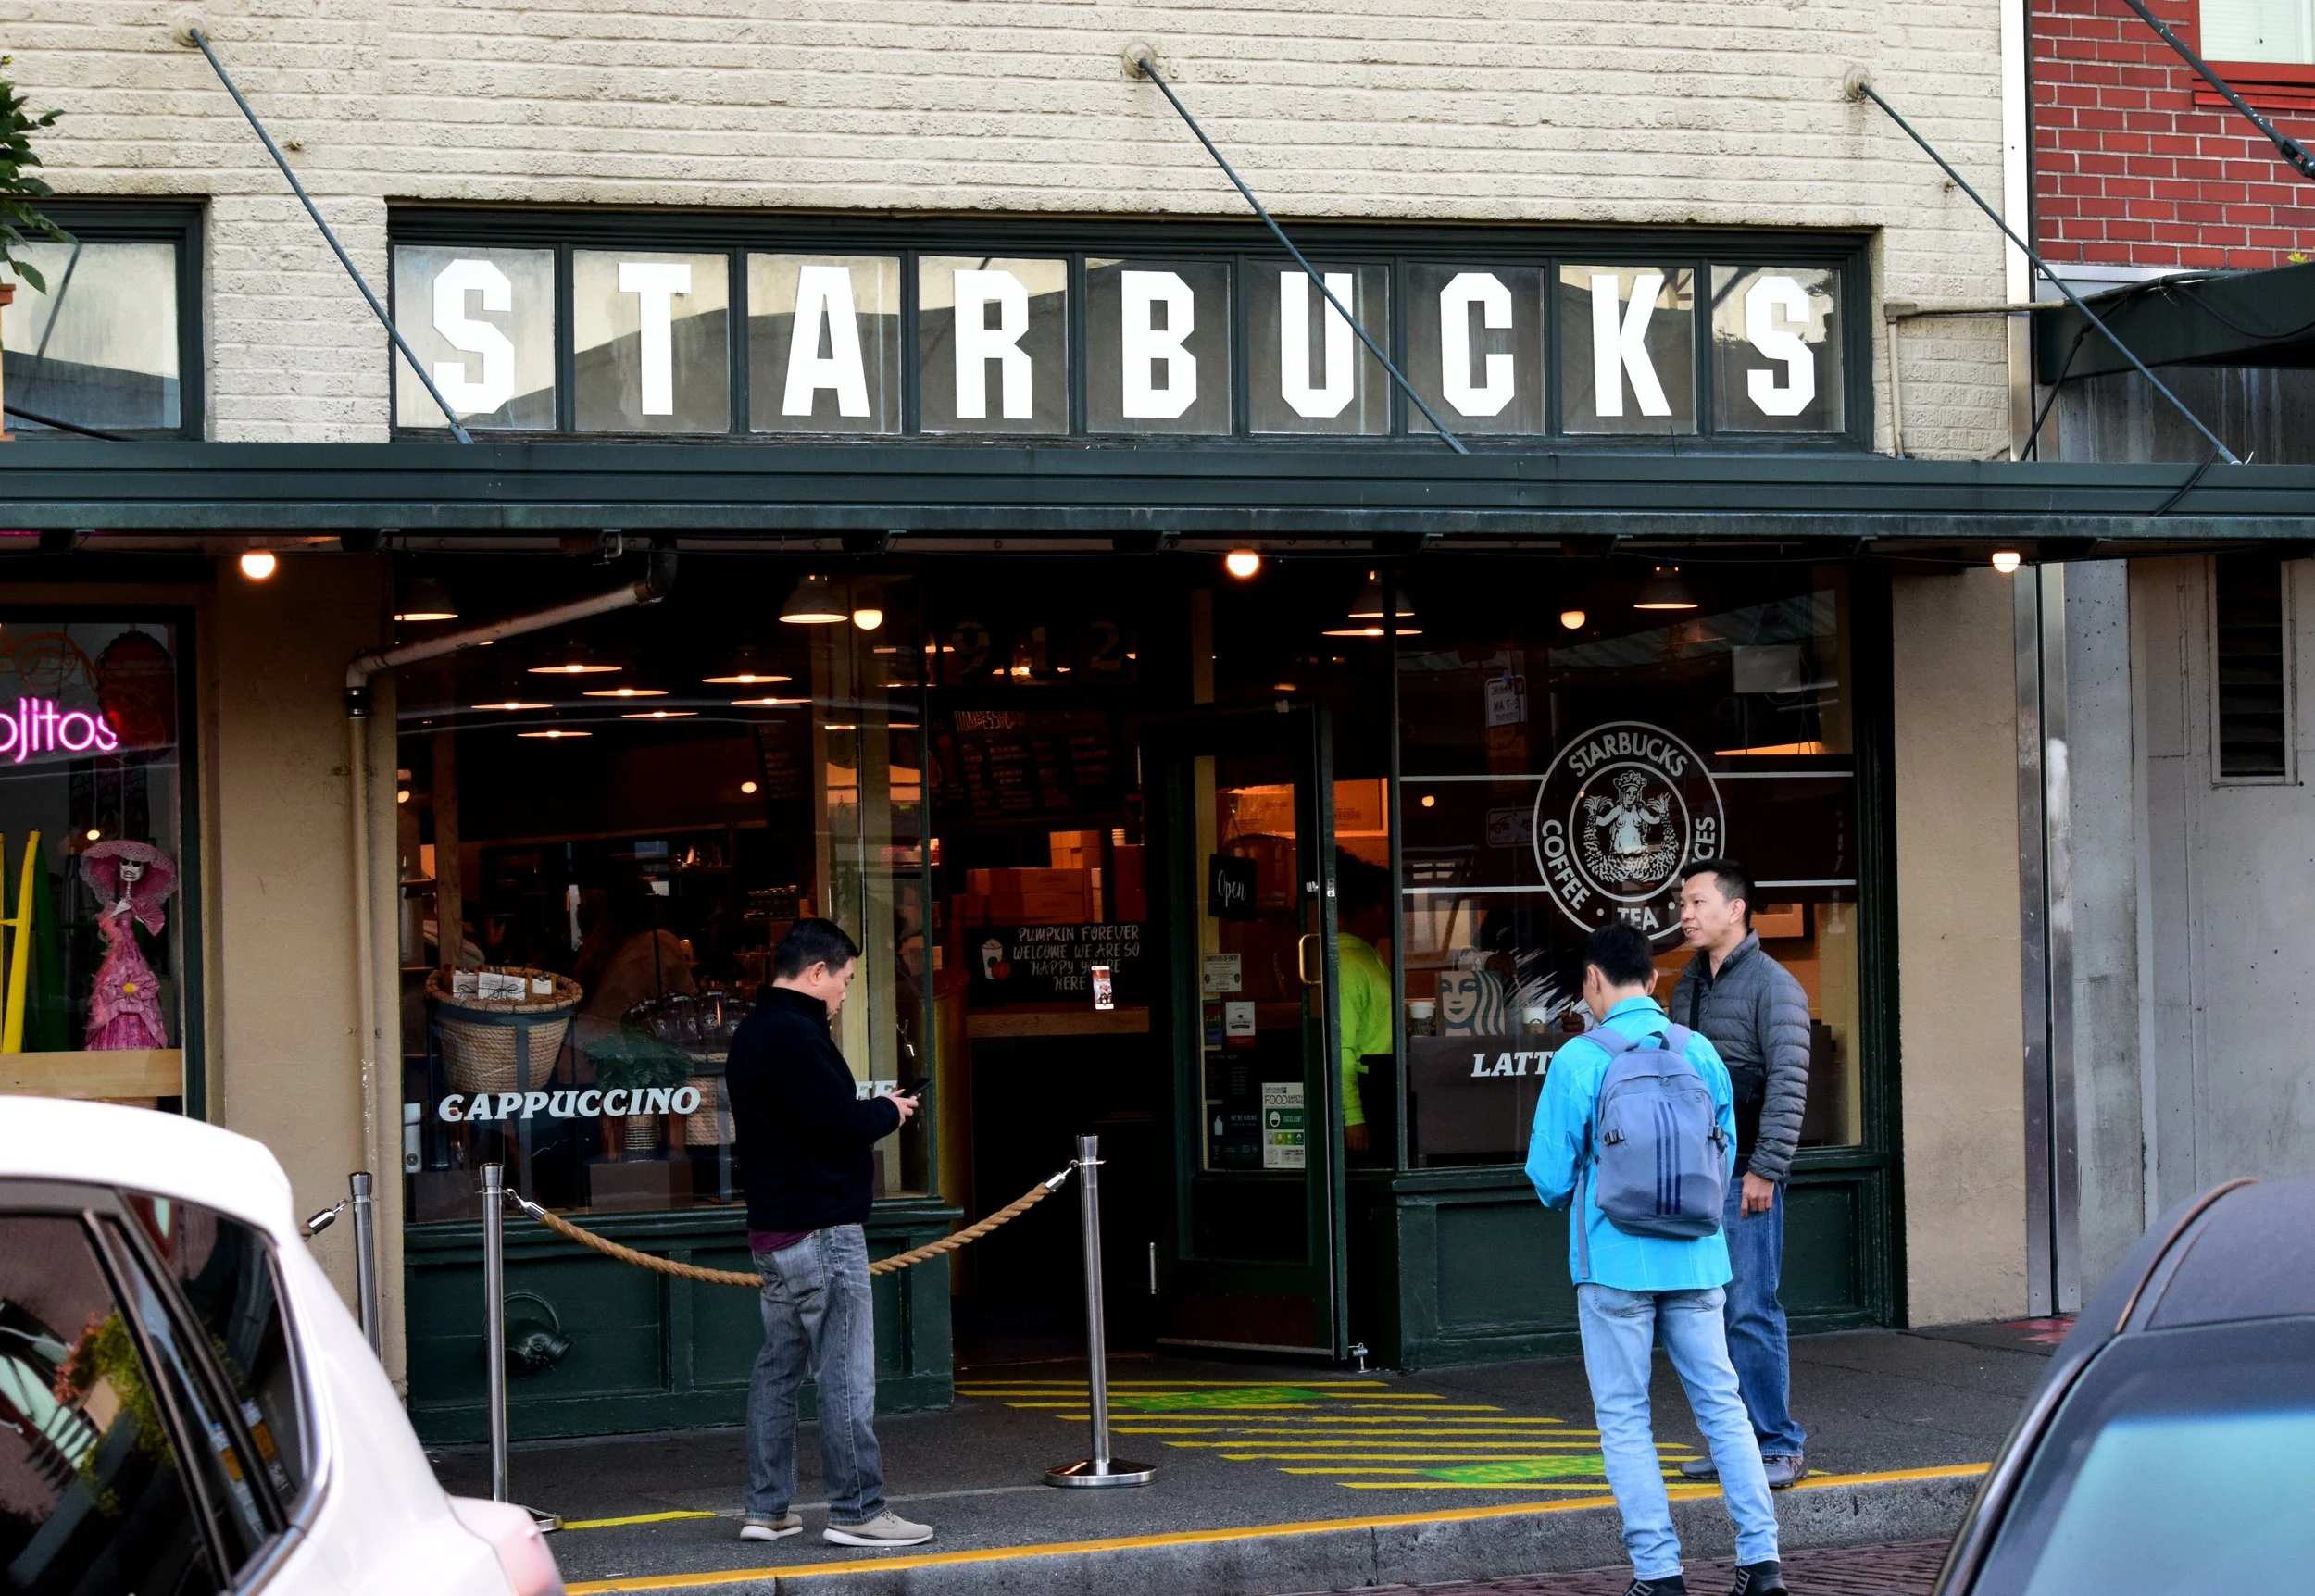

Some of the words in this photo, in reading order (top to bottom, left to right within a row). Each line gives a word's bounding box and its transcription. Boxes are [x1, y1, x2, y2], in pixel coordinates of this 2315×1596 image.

[432, 258, 1816, 419] STARBUCKS
[951, 617, 1122, 676] 912
[1569, 732, 1688, 777] STARBUCKS
[1218, 870, 1247, 907] Open
[1542, 819, 1591, 910] COFFEE
[1618, 907, 1659, 930] TEA
[1691, 817, 1716, 864] CES
[1018, 926, 1074, 942] PUMPKIN
[1081, 925, 1139, 941] FOREVER
[1013, 944, 1068, 960] WELCOME
[1074, 943, 1092, 959] WE
[1095, 942, 1120, 959] ARE
[1123, 941, 1140, 957] SO
[1030, 960, 1074, 976] HAPPY
[1053, 976, 1085, 991] HERE
[1470, 1052, 1554, 1078] LATT
[438, 1086, 702, 1123] CAPPUCCINO
[1265, 1095, 1287, 1104] FOOD
